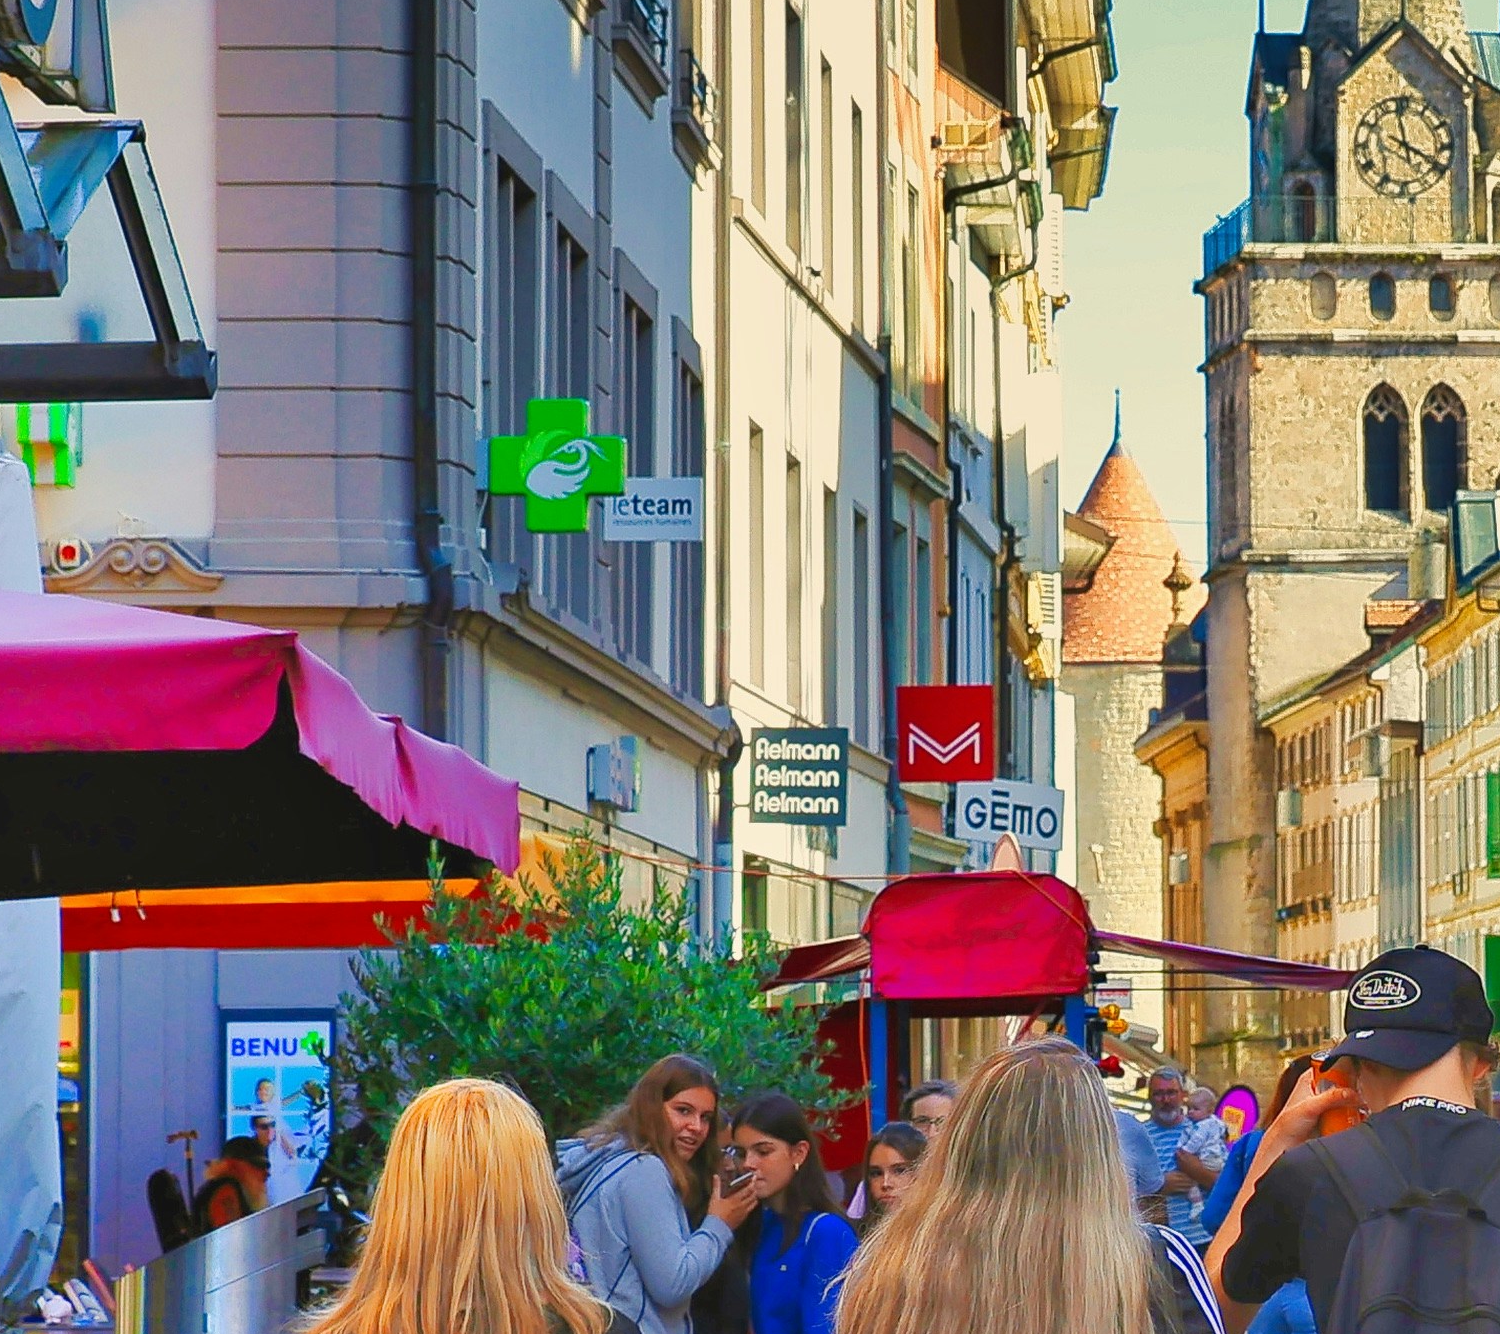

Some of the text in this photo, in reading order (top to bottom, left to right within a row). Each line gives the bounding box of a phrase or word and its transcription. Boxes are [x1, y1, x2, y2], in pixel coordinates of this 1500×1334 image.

[231, 1037, 298, 1057] BENU
[1401, 1097, 1467, 1115] NIKE PRO
